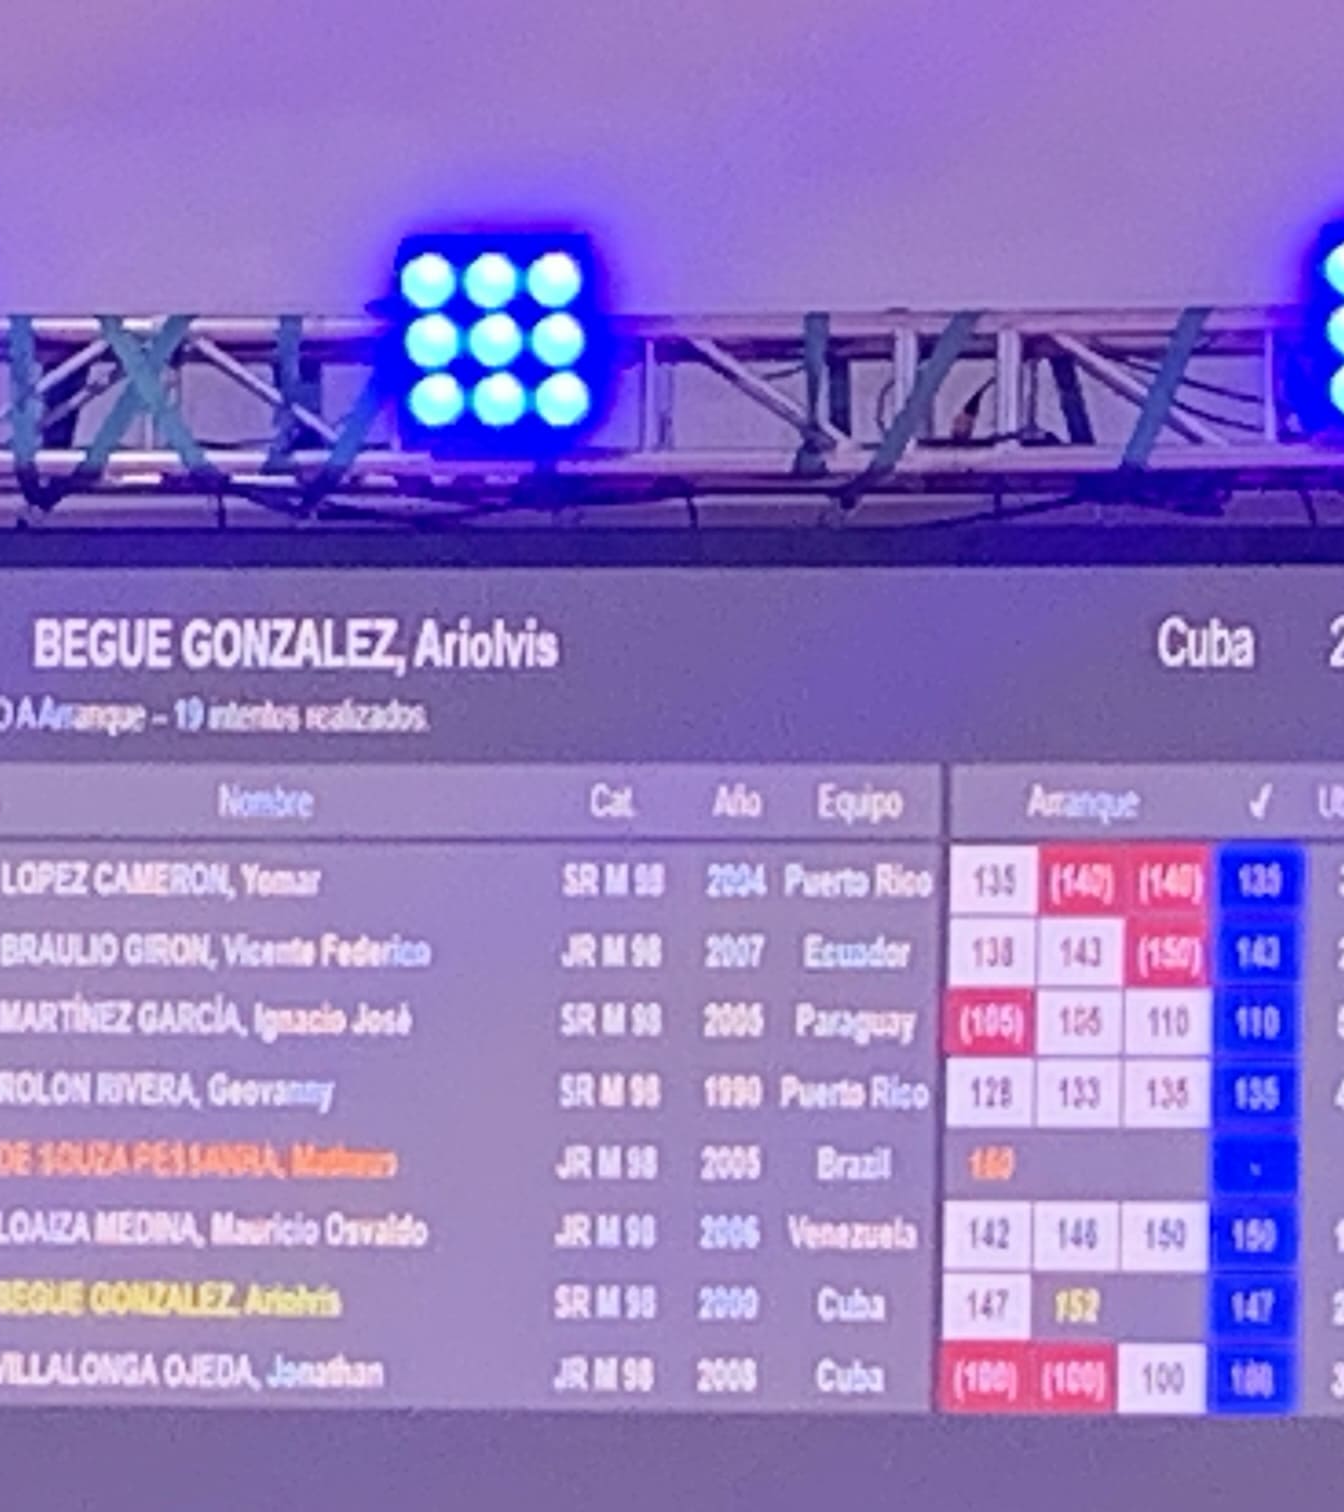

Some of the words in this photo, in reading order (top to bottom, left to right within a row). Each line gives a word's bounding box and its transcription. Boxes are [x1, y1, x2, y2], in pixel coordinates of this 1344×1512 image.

[34, 619, 172, 668] BEGUE
[181, 619, 407, 676] GONZALEZ,
[415, 619, 560, 669] Ariolvis
[1158, 617, 1254, 668] Cuba
[38, 698, 146, 737] Arranque
[217, 784, 314, 818] Nombre
[712, 783, 762, 818] Año
[817, 784, 904, 826] Equipo
[1027, 784, 1139, 826] Arranque
[1, 862, 89, 894] LOPEZ
[93, 862, 236, 900] CAMERON,
[563, 863, 599, 896] SR
[605, 863, 629, 896] M
[784, 863, 869, 897] Puerto
[874, 864, 932, 897] Rico
[974, 865, 1017, 896] 135
[0, 935, 118, 967] BRAULIO
[123, 935, 218, 970] GIRON,
[223, 936, 314, 967] Vicente
[321, 936, 431, 967] Federico
[562, 935, 597, 967] JR
[601, 935, 626, 967] M
[705, 935, 765, 967] 2007
[803, 935, 911, 968] Ecuador
[1060, 937, 1102, 967] 143
[138, 993, 248, 1038] GARCÍA,
[255, 1002, 346, 1043] Ignacio
[351, 1000, 412, 1036] José
[561, 1002, 596, 1036] SR
[601, 1002, 626, 1036] M
[794, 1003, 917, 1045] Paraguay
[1148, 1006, 1189, 1037] 110
[97, 1072, 202, 1109] RIVERA,
[207, 1073, 336, 1113] Geovanny
[561, 1073, 595, 1107] SR
[599, 1073, 624, 1107] M
[780, 1074, 866, 1108] Puerto
[870, 1074, 930, 1109] Rico
[1058, 1076, 1100, 1108] 133
[1147, 1076, 1189, 1109] 135
[556, 1146, 592, 1179] JR
[598, 1146, 622, 1179] M
[817, 1146, 892, 1180] Brazil
[94, 1212, 205, 1249] MEDINA,
[211, 1213, 319, 1247] Mauricio
[325, 1213, 429, 1246] Osvaldo
[555, 1215, 591, 1249] JR
[596, 1215, 621, 1249] M
[787, 1216, 918, 1249] Venezuela
[968, 1218, 1010, 1250] 142
[1145, 1218, 1187, 1250] 150
[89, 1281, 241, 1318] GONZALEZ,
[556, 1285, 591, 1319] SR
[596, 1285, 620, 1319] M
[817, 1286, 886, 1321] Cuba
[966, 1289, 1009, 1320] 147
[1055, 1290, 1100, 1323] 152
[163, 1353, 261, 1391] OJEDA,
[267, 1355, 383, 1388] Jonathan
[554, 1356, 590, 1391] JR
[594, 1356, 619, 1391] M
[816, 1357, 885, 1393] Cuba
